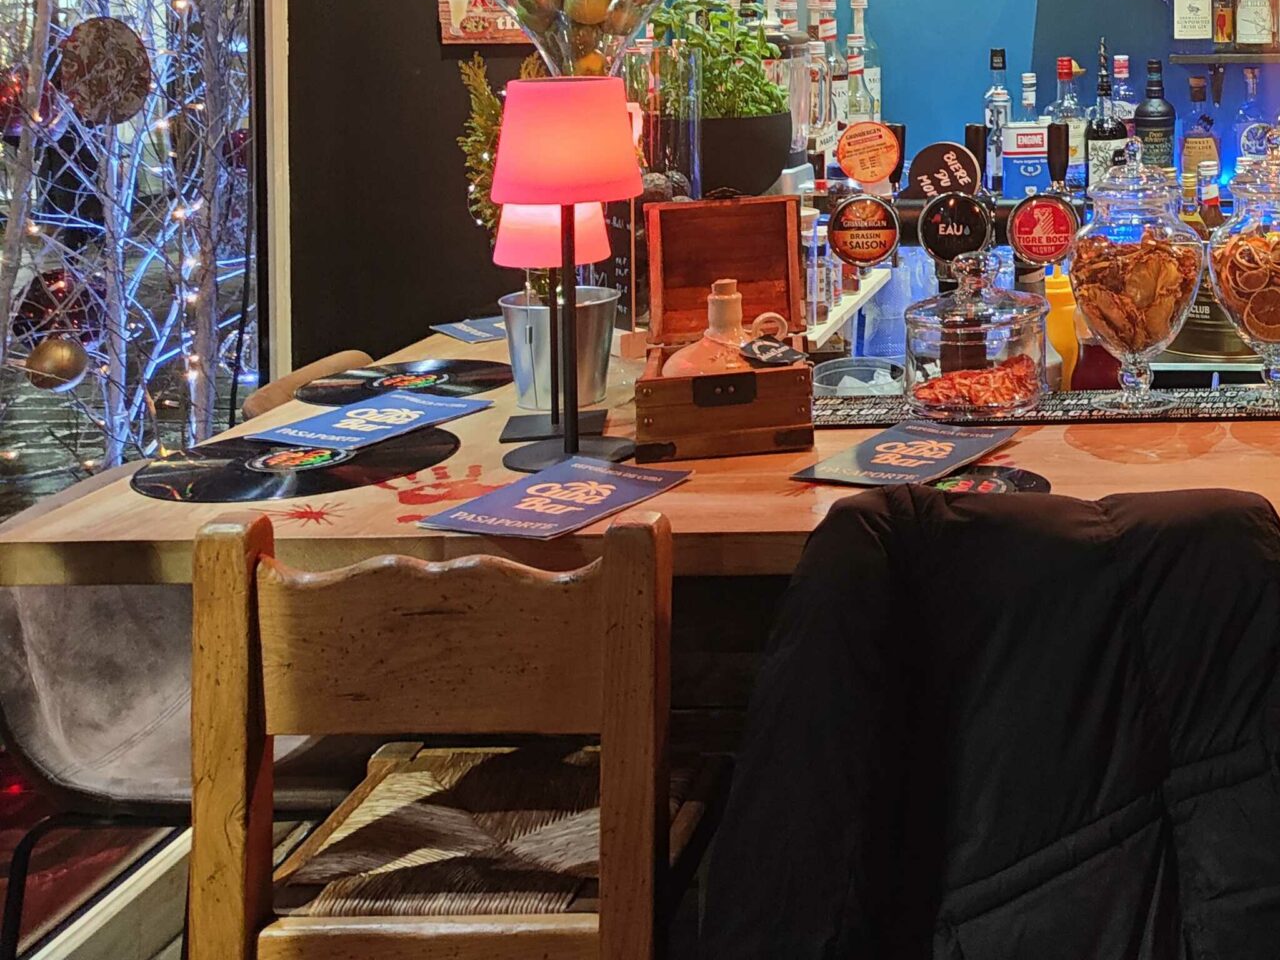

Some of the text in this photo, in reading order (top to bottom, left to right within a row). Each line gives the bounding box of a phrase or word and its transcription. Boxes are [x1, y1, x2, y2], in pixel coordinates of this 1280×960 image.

[1017, 134, 1043, 145] ENGINE
[933, 168, 952, 187] DU
[938, 223, 963, 236] EAU
[848, 240, 887, 250] SAISON
[1017, 235, 1070, 244] TIGRE BOCK
[345, 408, 426, 426] Cuba
[332, 418, 394, 432] Bar
[274, 428, 367, 442] PASAPORTE
[875, 440, 956, 460] Cuba
[870, 453, 936, 468] Bar
[817, 465, 920, 481] PASAPORTE
[525, 480, 617, 505] Cuba
[512, 496, 586, 515] Bar
[449, 510, 560, 530] PASAPORTE
